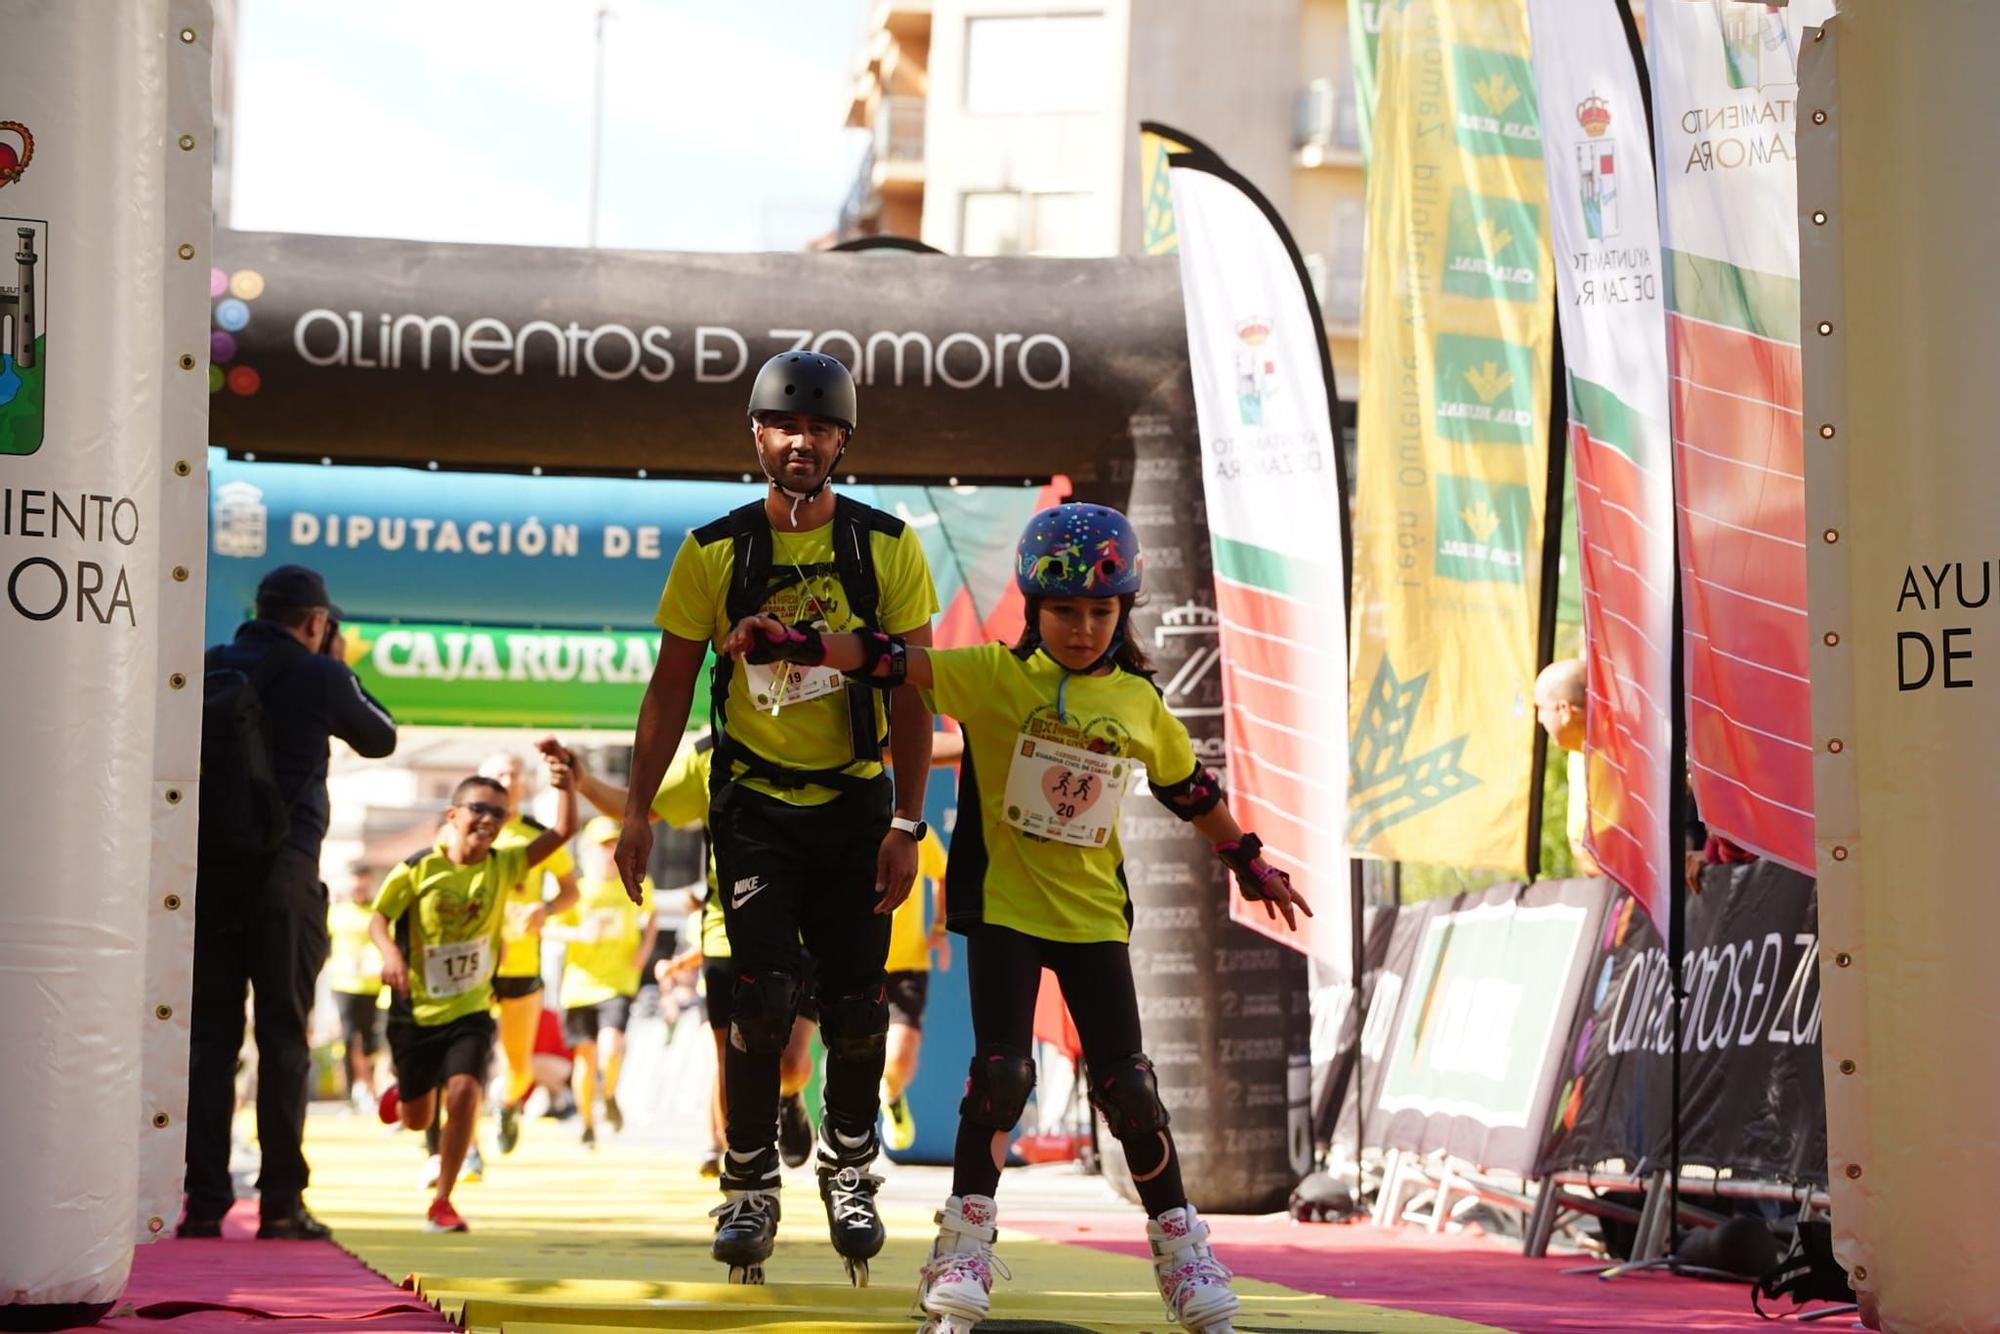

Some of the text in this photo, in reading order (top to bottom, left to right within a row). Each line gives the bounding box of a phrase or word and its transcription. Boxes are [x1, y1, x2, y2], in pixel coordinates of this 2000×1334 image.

[4, 488, 139, 546] IENTO
[290, 512, 662, 559] DIPUTACIÓN DE
[8, 556, 136, 627] ORA
[1896, 560, 2000, 612] AYU
[372, 630, 662, 684] CAJA RURA
[788, 672, 801, 684] 19
[1897, 627, 1973, 691] DE
[1056, 803, 1075, 818] 20
[733, 875, 759, 896] NIKE
